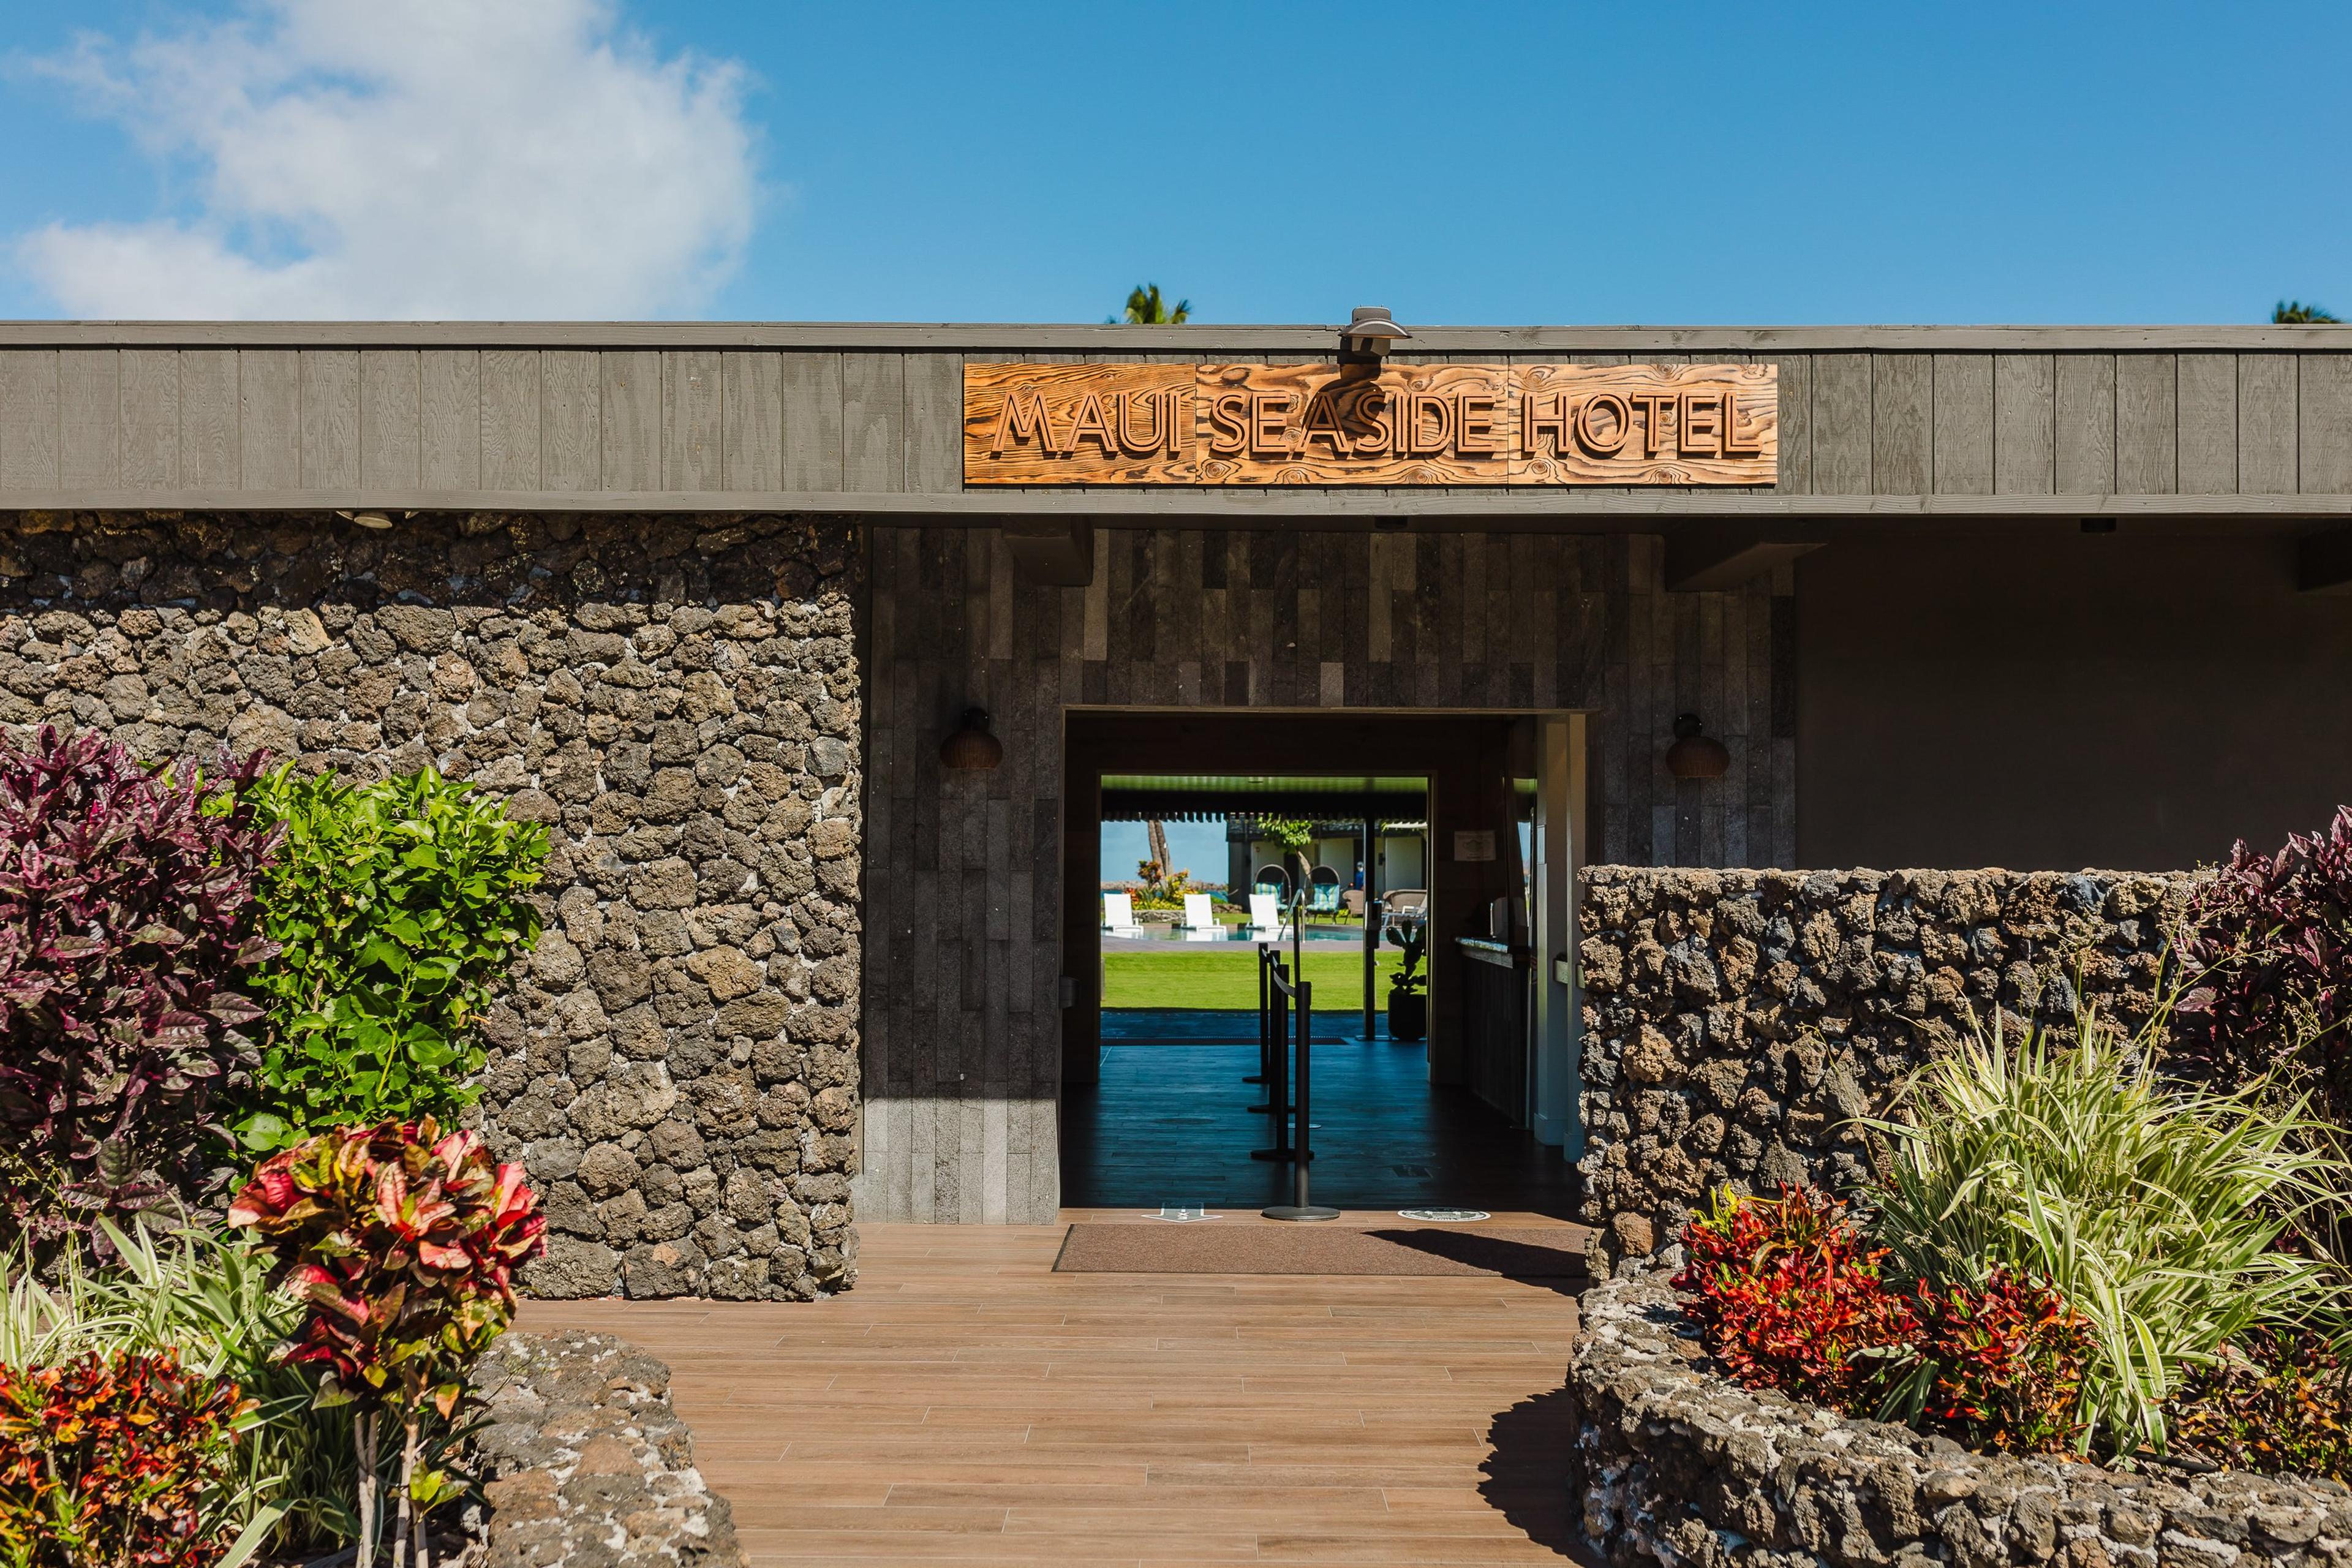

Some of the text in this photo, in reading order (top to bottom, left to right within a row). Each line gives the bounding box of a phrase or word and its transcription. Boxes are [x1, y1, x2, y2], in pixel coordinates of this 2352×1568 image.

[991, 390, 1763, 453] MAUI SEASIDE HOTEL
